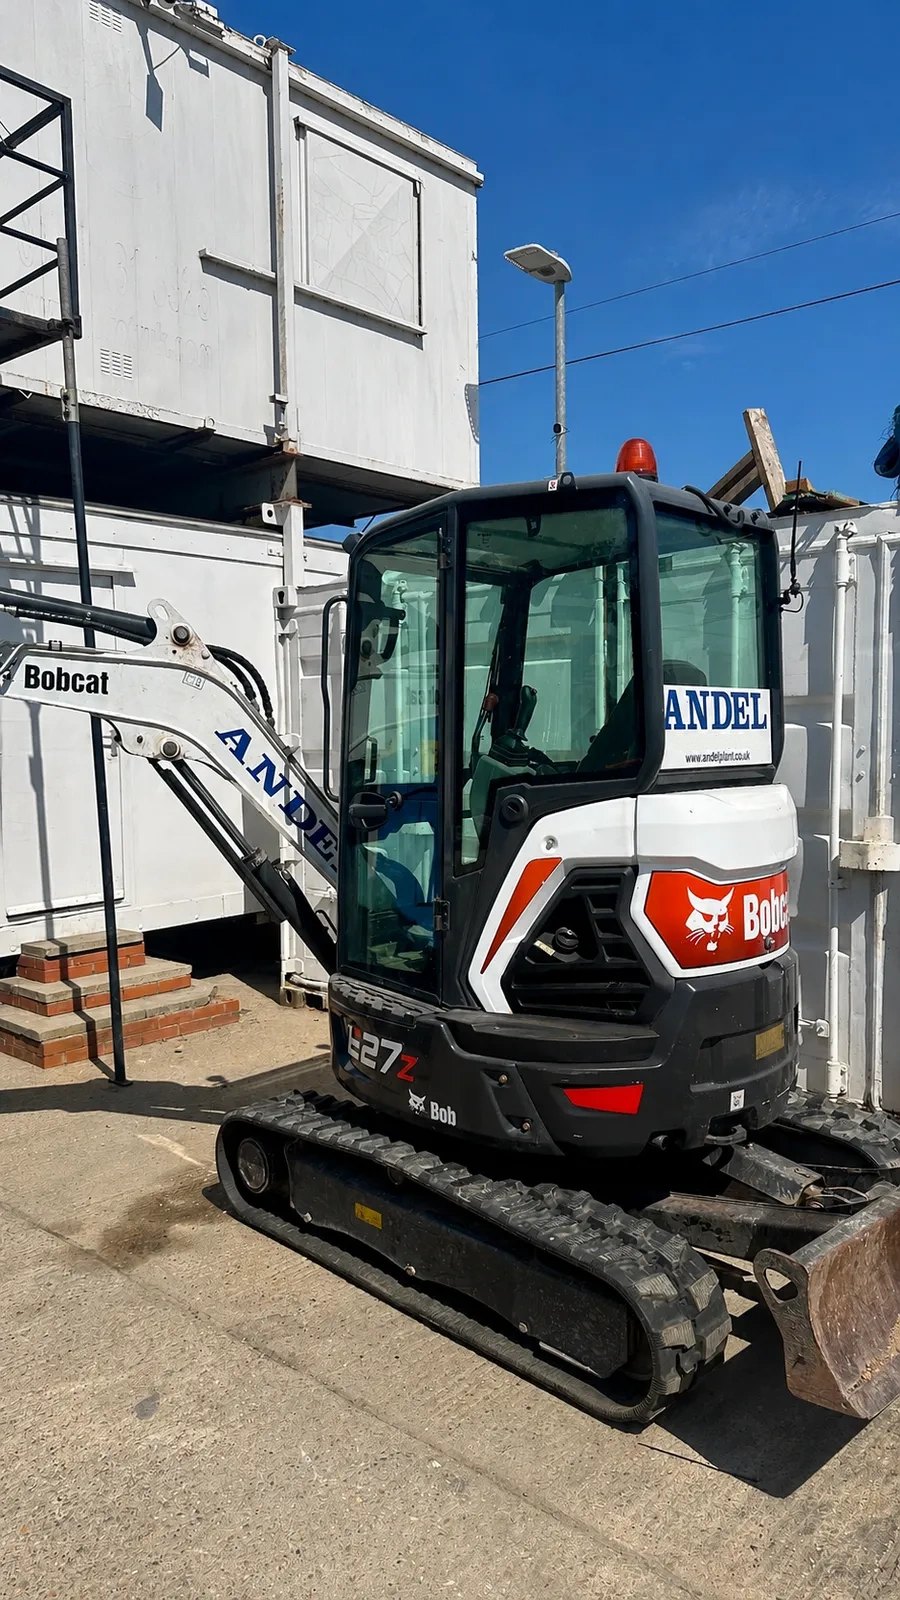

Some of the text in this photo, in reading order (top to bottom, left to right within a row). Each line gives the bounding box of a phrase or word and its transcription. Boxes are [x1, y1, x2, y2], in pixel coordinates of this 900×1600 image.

[24, 664, 109, 695] Bobcat
[665, 689, 767, 730] ANDEL
[685, 751, 750, 764] www.andelplant.co.uk
[214, 727, 338, 871] ANDE
